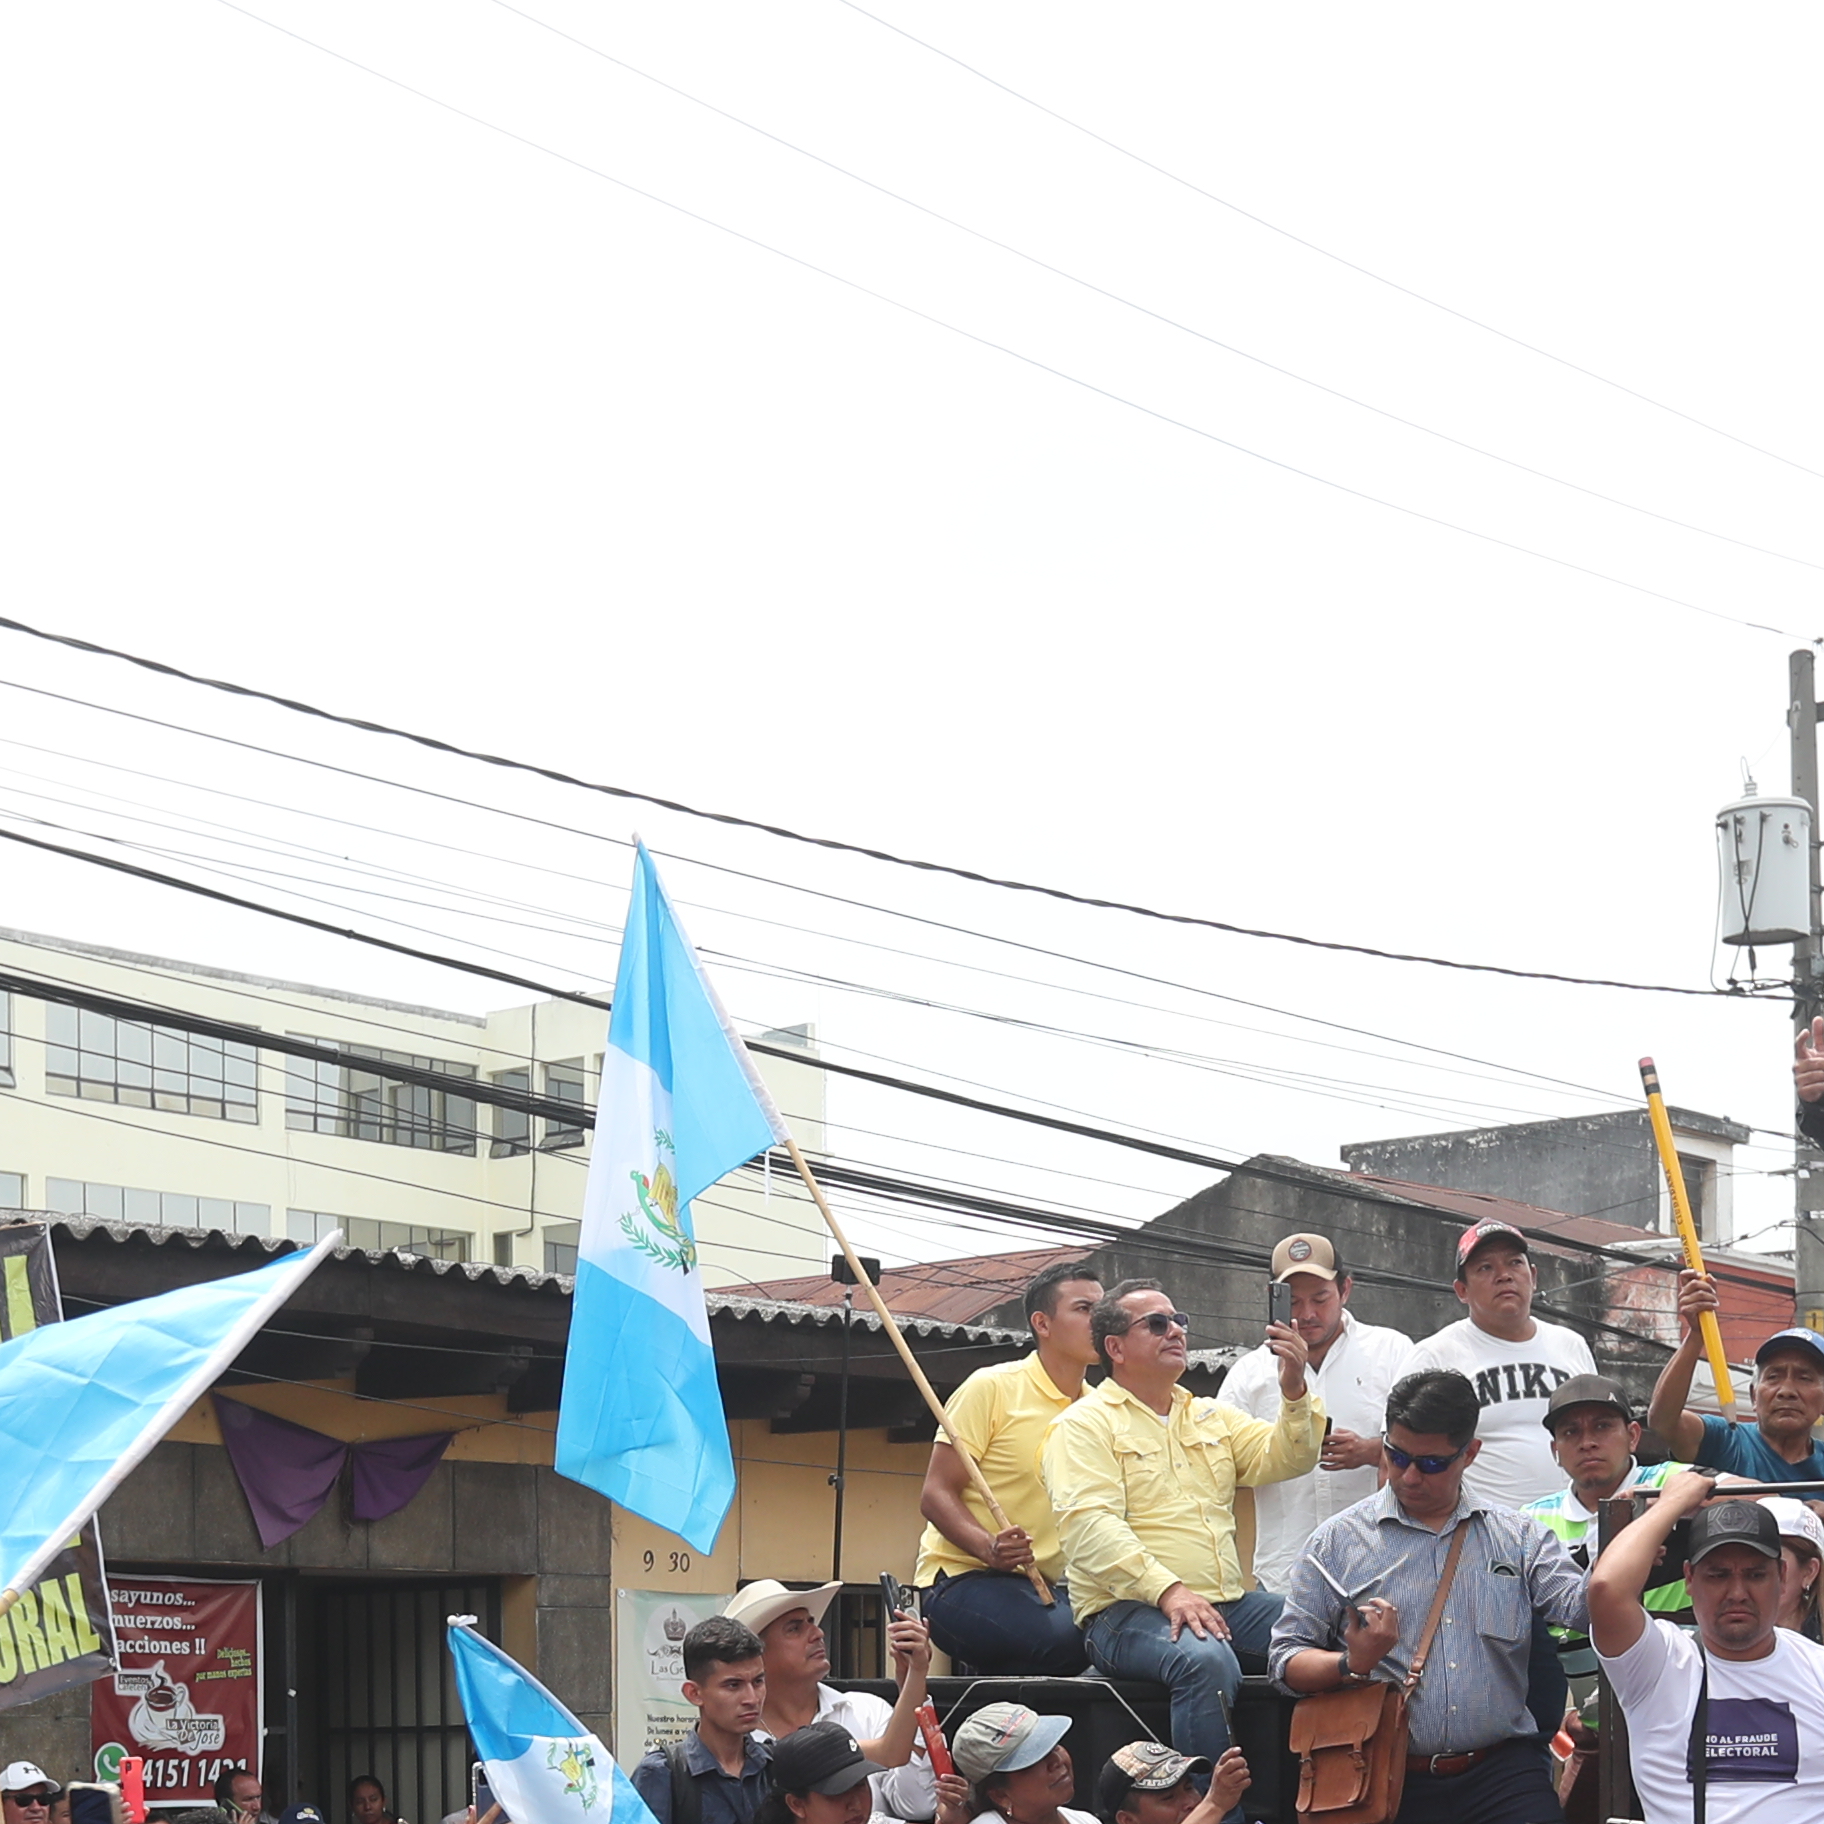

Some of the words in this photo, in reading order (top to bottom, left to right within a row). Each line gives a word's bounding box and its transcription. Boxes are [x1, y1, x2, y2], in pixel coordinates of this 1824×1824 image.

[643, 1549, 654, 1572] 9
[668, 1551, 690, 1573] 30
[111, 1589, 195, 1608] sayunos...
[112, 1614, 195, 1630] muerzos...
[116, 1635, 190, 1655] acciones
[195, 1638, 206, 1655] !!
[651, 1661, 668, 1675] Las
[670, 1661, 684, 1675] Ge
[166, 1719, 177, 1729] La
[180, 1719, 218, 1731] Victoria
[647, 1714, 675, 1722] Nuestro
[656, 1727, 673, 1735] lunes
[1720, 1736, 1733, 1744] AL
[1735, 1733, 1778, 1743] FRAUDE
[143, 1758, 190, 1788] 4151
